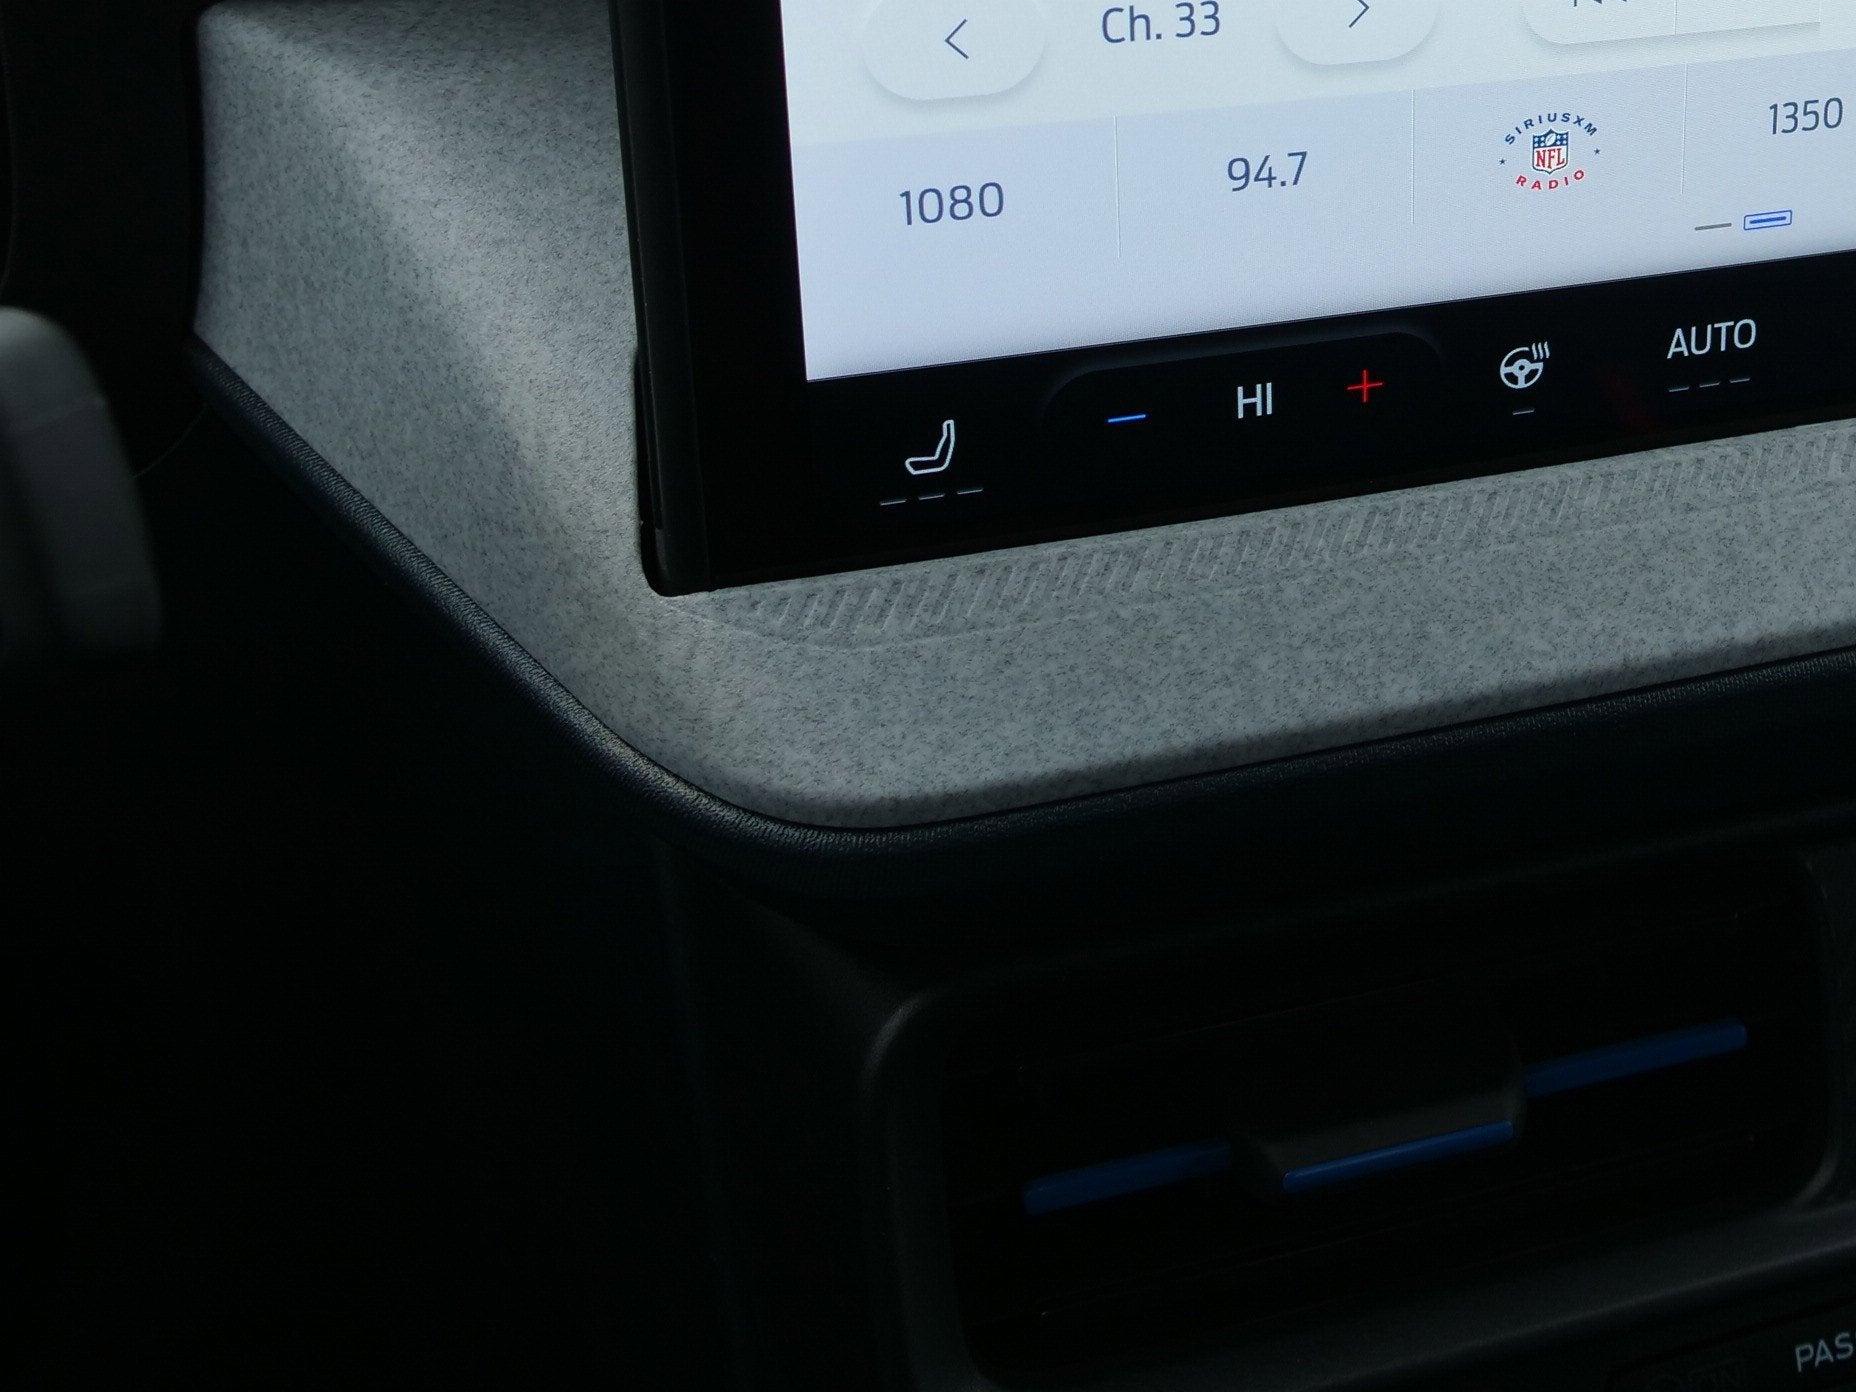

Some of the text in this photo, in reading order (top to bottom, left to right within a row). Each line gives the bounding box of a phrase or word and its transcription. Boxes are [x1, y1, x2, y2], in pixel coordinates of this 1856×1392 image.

[1101, 0, 1222, 44] Ch. 33
[1505, 112, 1598, 145] SIRIUSXM
[1768, 96, 1845, 136] 1350
[1226, 150, 1308, 192] 94.7
[1535, 147, 1565, 169] NFL
[1515, 169, 1585, 190] RADIO
[899, 181, 1006, 226] 1080
[1666, 317, 1757, 359] AUTO
[1236, 381, 1273, 419] HI
